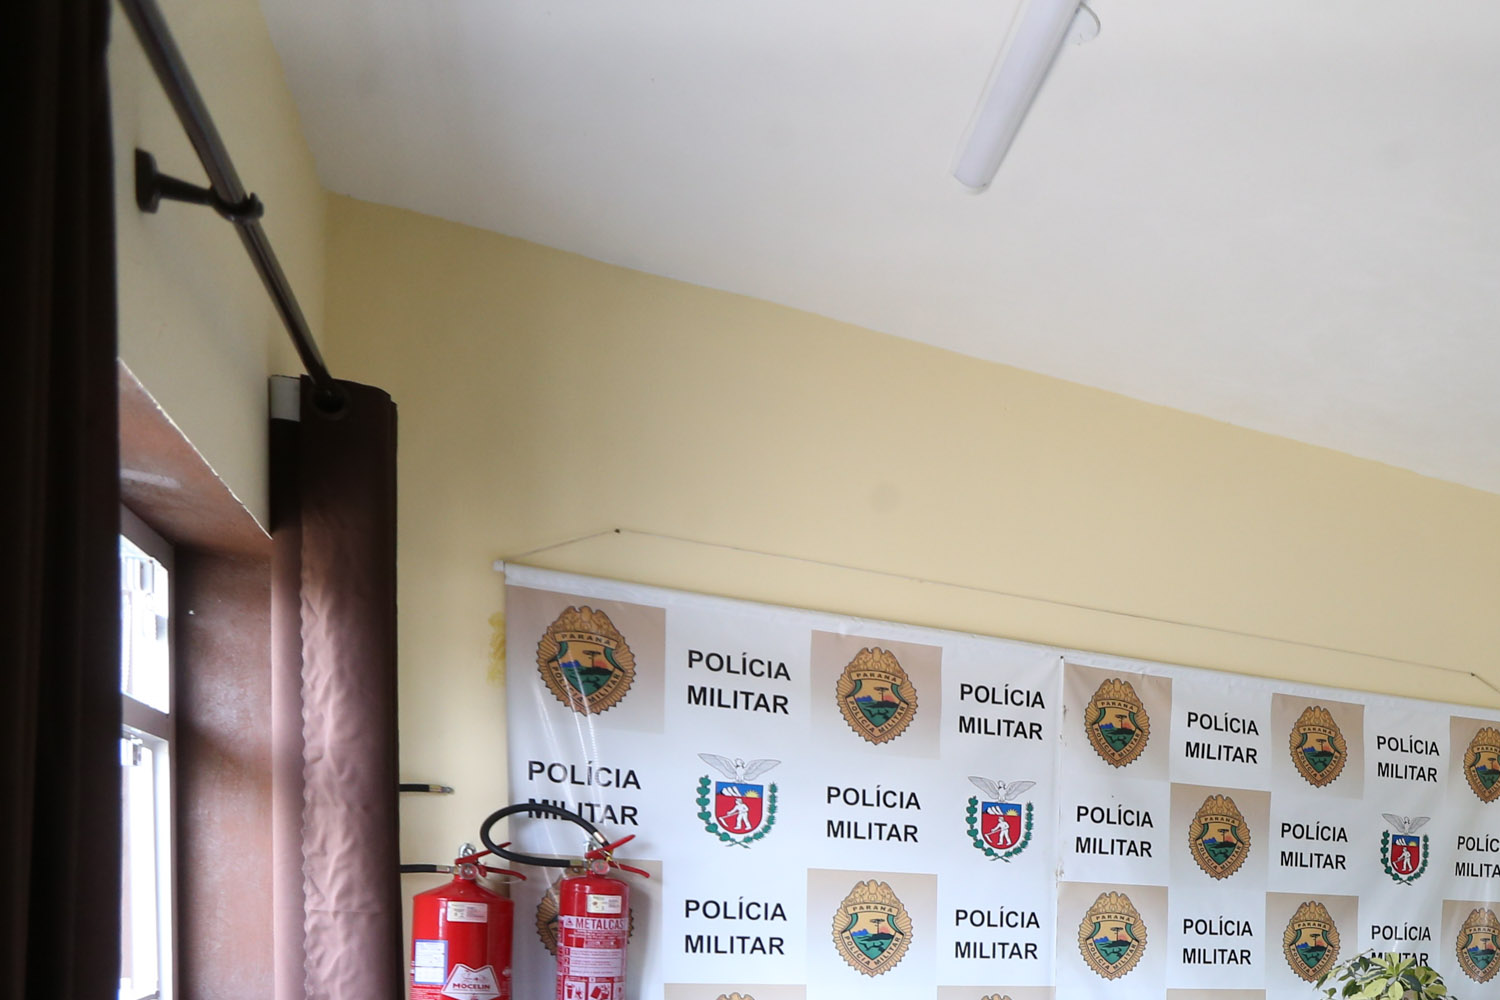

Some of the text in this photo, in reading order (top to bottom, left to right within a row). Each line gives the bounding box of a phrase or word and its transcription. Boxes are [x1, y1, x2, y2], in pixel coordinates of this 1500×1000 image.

[687, 649, 791, 681] POLÍCIA
[687, 685, 789, 715] MILITAR
[960, 683, 1046, 709] POLÍCIA
[959, 715, 1043, 741] MILITAR
[1187, 711, 1259, 736] POLÍCIA
[1185, 741, 1258, 764] MILITAR
[1376, 734, 1440, 757] POLÍCIA
[528, 760, 641, 790] POLÍCIA
[1377, 761, 1438, 783] MILITAR
[827, 785, 921, 810] POLÍCIA
[1076, 804, 1154, 828] POLÍCIA
[827, 819, 919, 843] MILITAR
[1280, 821, 1348, 843] POLÍCIA
[1075, 836, 1153, 858] MILITAR
[1280, 850, 1346, 870] MILITAR
[684, 896, 787, 921] POLÍCIA
[955, 906, 1040, 929] POLÍCIA
[1183, 915, 1253, 937] POLÍCIA
[1371, 922, 1432, 941] POLÍCIA
[684, 934, 785, 955] MILITAR
[955, 941, 1038, 960] MILITAR
[1182, 947, 1252, 965] MILITAR
